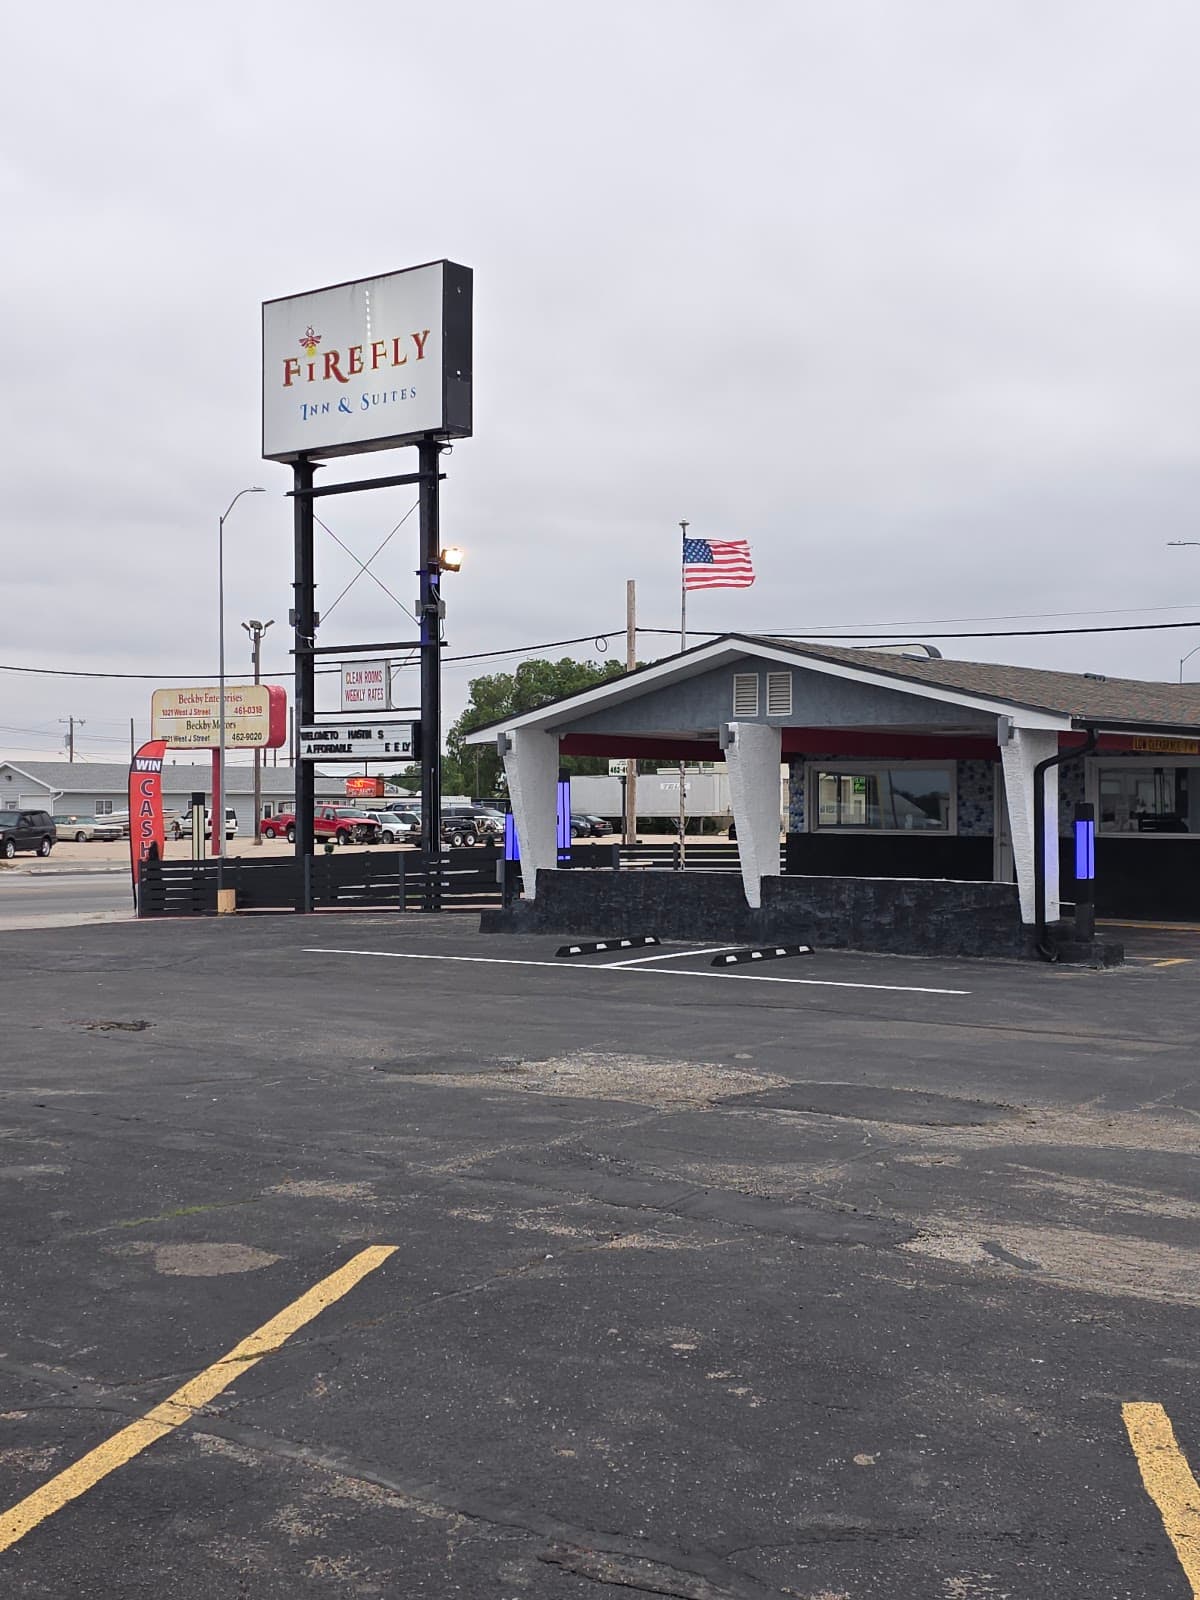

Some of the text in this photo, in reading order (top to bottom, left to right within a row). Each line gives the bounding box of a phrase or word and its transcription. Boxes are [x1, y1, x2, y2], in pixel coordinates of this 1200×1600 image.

[338, 396, 353, 413] &
[345, 670, 383, 685] CLEAN ROOMS
[178, 692, 243, 705] Beckby Enteprises
[344, 688, 384, 702] WEEKLY RATES
[173, 708, 188, 717] West
[193, 708, 211, 716] Street
[186, 720, 211, 732] Beckby
[173, 735, 189, 743] West
[193, 734, 210, 742] Street
[231, 732, 262, 741] 462-9020
[135, 759, 161, 772] WIN
